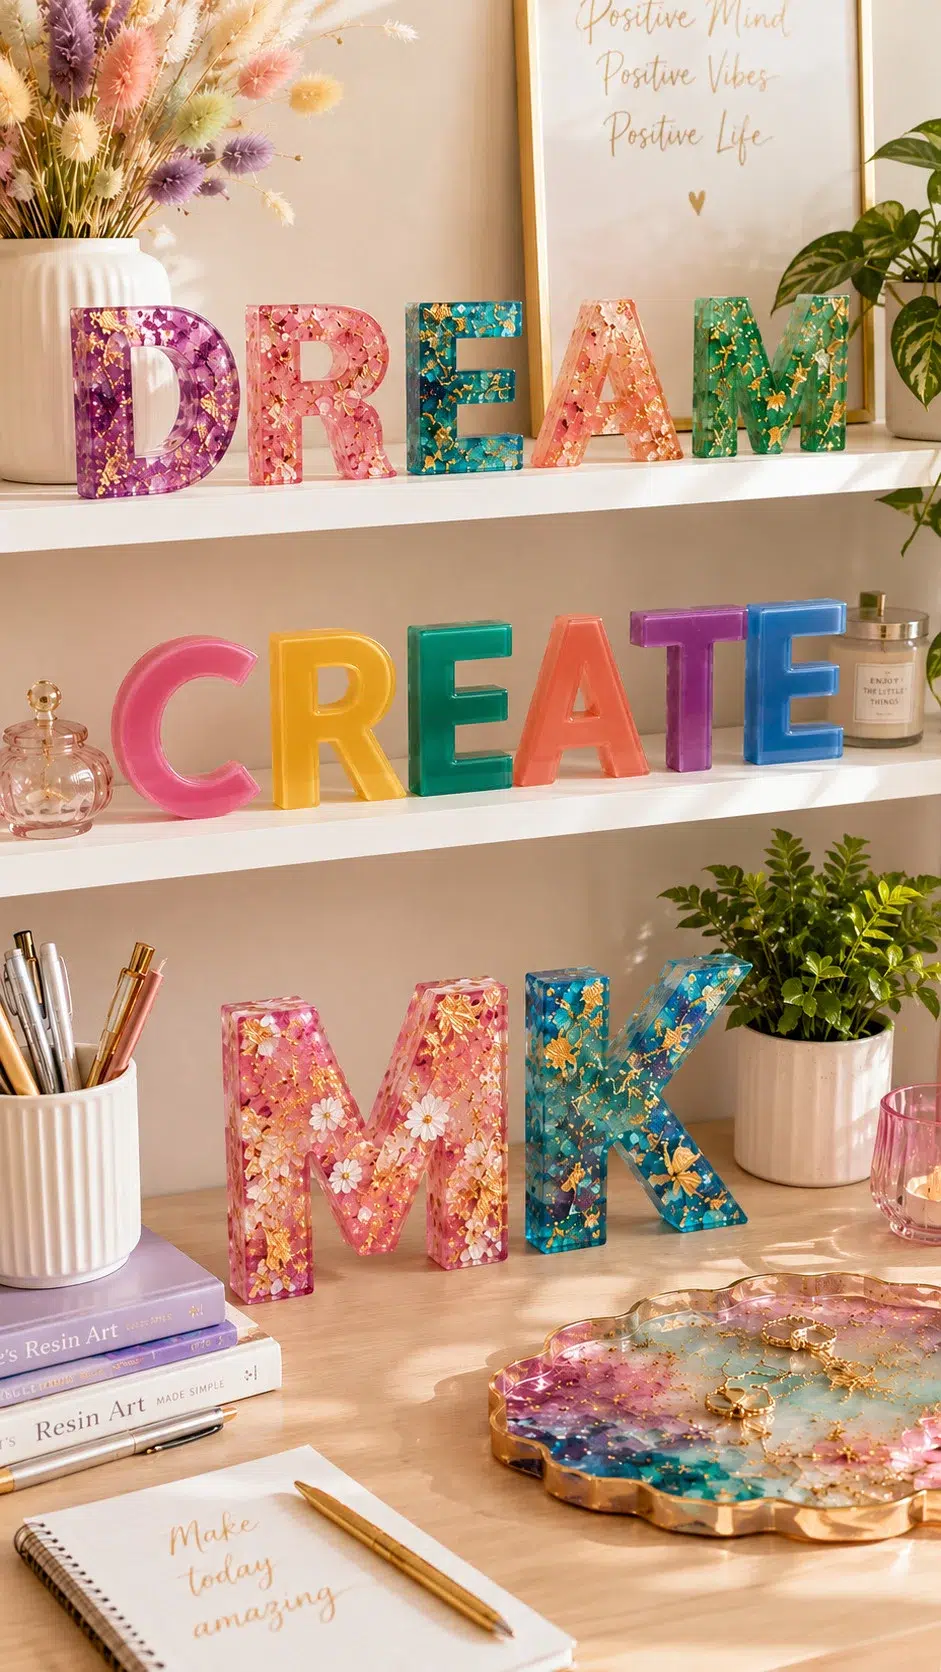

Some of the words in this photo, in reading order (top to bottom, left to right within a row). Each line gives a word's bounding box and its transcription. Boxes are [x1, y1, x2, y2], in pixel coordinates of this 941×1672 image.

[576, 0, 696, 45] Positive
[705, 0, 791, 38] Mind
[596, 50, 696, 96] Positive
[708, 49, 780, 93] Vibes
[603, 111, 703, 156] Positive
[716, 109, 773, 166] Life
[70, 295, 850, 499] DREAM
[869, 677, 899, 685] ENJOY
[870, 698, 899, 706] THINGS
[110, 598, 847, 819] CREATE
[25, 1330, 80, 1360] Resin
[85, 1323, 119, 1344] Art
[35, 1410, 100, 1442] Resin
[109, 1396, 146, 1422] Art
[156, 1390, 185, 1406] MADE
[189, 1379, 225, 1397] SIMPLE
[169, 1512, 260, 1556] Make
[177, 1553, 277, 1597] today
[193, 1584, 348, 1638] amazing
